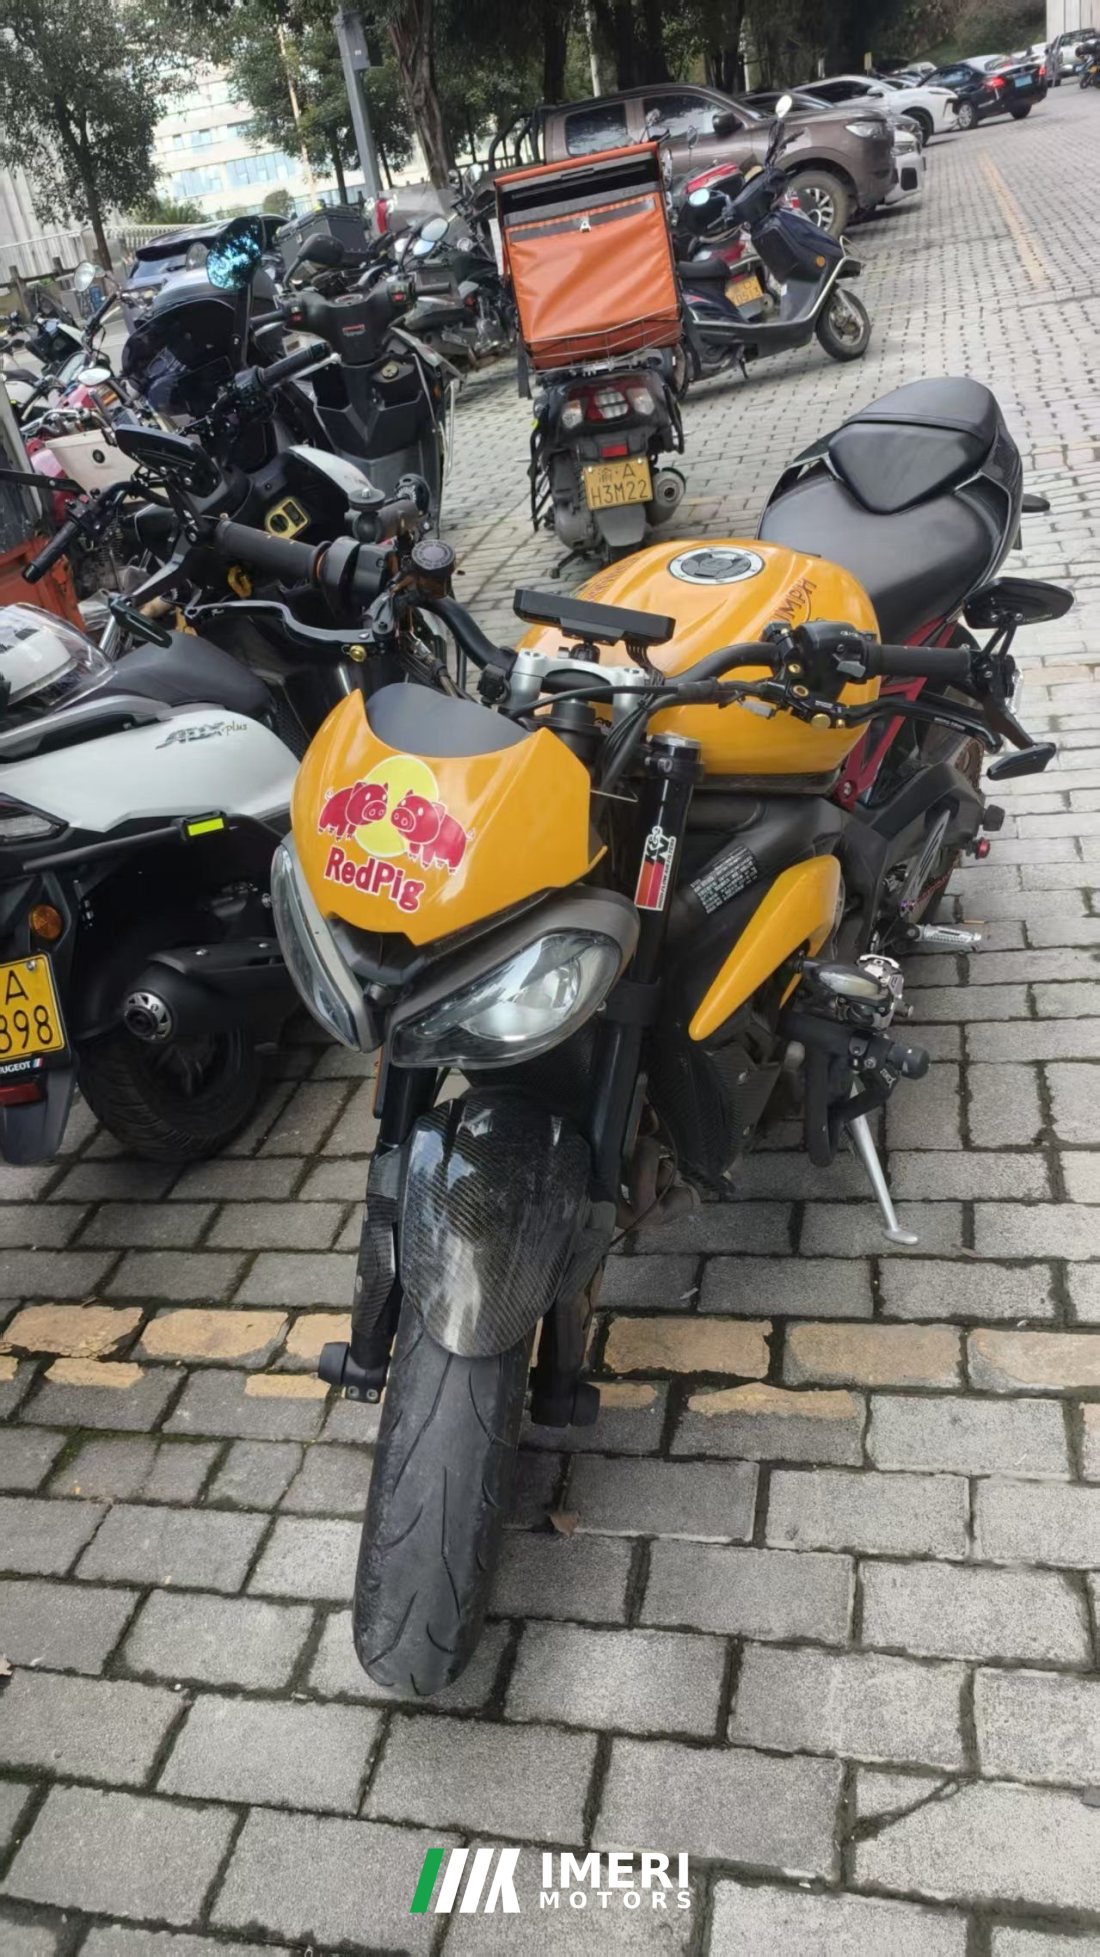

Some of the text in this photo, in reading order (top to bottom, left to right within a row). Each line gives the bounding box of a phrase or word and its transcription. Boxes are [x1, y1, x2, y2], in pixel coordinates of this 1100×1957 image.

[590, 479, 649, 507] H3M22
[323, 844, 426, 913] RedPig
[5, 969, 29, 1005] A
